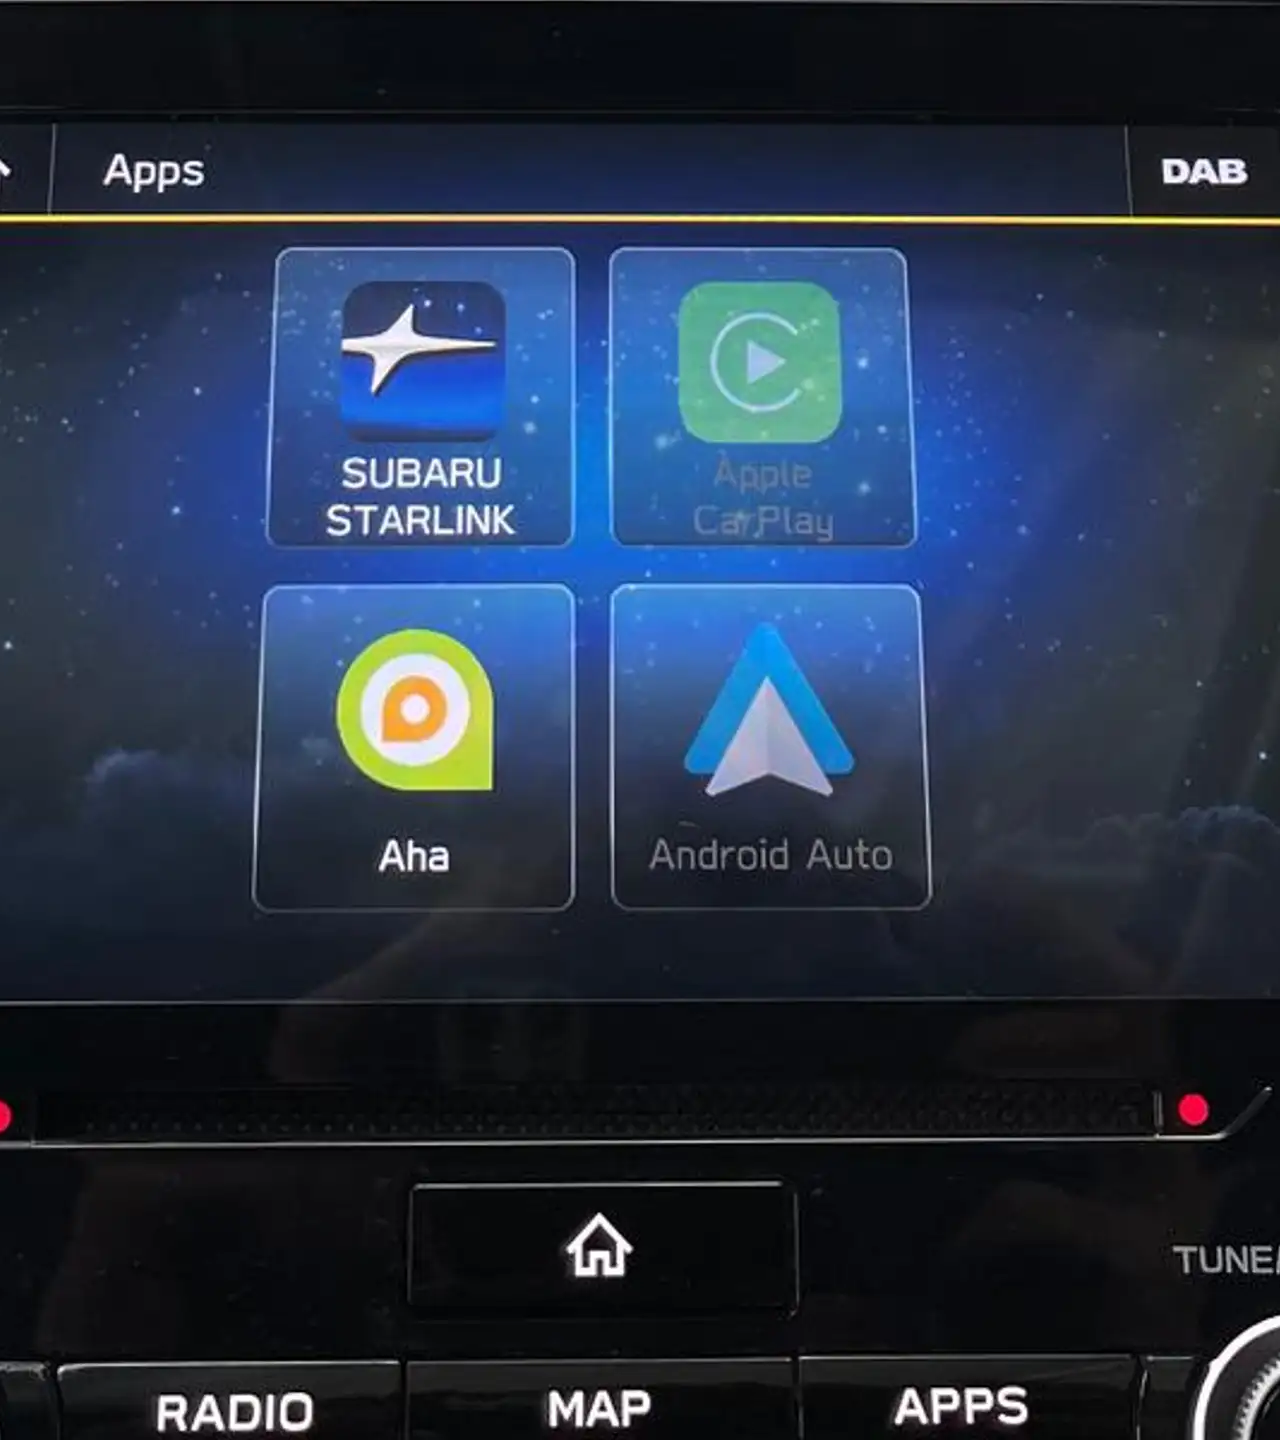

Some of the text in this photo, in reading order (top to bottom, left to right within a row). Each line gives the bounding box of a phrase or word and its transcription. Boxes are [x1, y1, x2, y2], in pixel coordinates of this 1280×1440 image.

[103, 153, 205, 194] Apps
[1162, 158, 1248, 185] DAB
[341, 456, 502, 490] SUBARU
[713, 455, 813, 496] Apple
[326, 503, 517, 537] STARLINK
[693, 505, 835, 542] CarPlay
[378, 839, 450, 872] Aha
[648, 838, 894, 871] Android Auto
[156, 1392, 314, 1432] RADIO
[547, 1389, 652, 1428] MAP
[894, 1386, 1029, 1425] APPS
